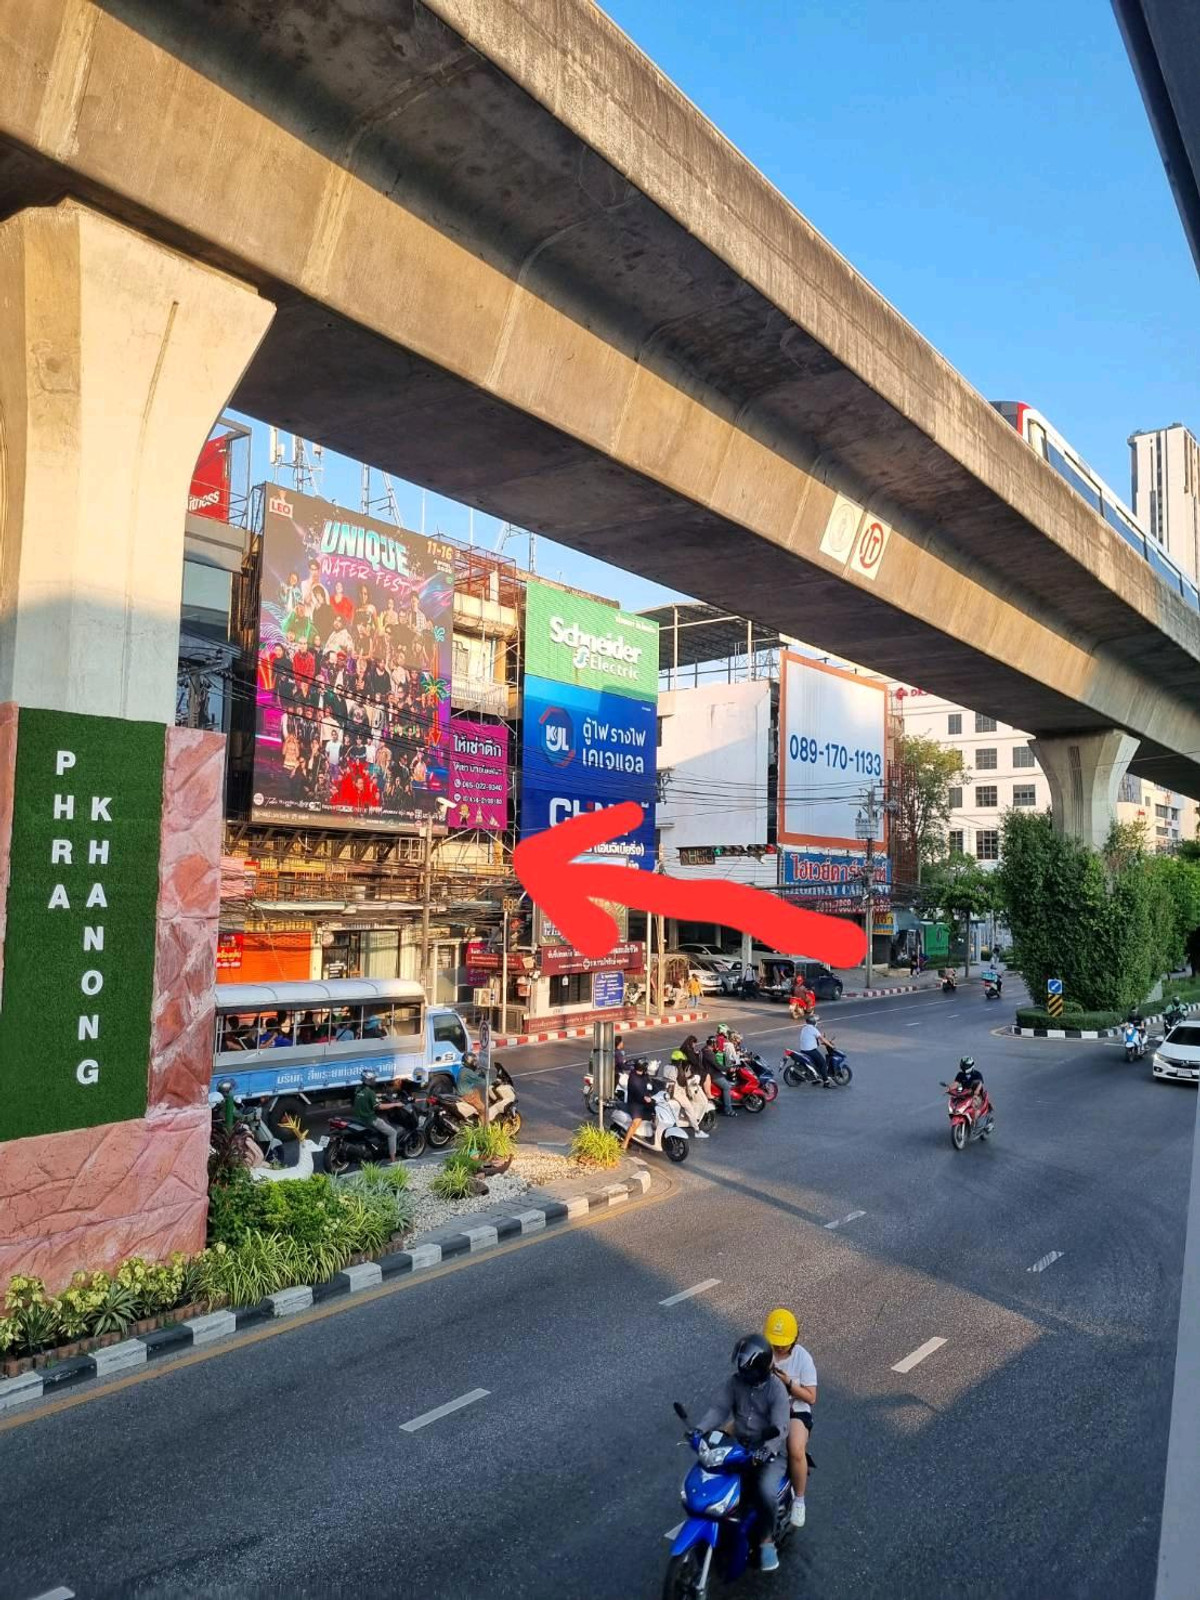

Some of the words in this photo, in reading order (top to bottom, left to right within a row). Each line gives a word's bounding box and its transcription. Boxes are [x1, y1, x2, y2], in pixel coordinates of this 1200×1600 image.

[271, 501, 291, 515] LEO
[320, 519, 411, 577] UNIQUE
[426, 540, 453, 560] 11-16
[321, 556, 370, 580] WATER
[375, 570, 411, 597] FEST
[549, 615, 642, 665] Schneider
[590, 655, 639, 681] Electric
[583, 716, 609, 746] ตู้ไฟ
[610, 727, 646, 748] รางไฟ
[583, 747, 645, 774] เคเจแอล
[789, 734, 882, 777] 089-170-1133
[48, 750, 76, 910] PHRA
[75, 796, 113, 1086] KHANONG
